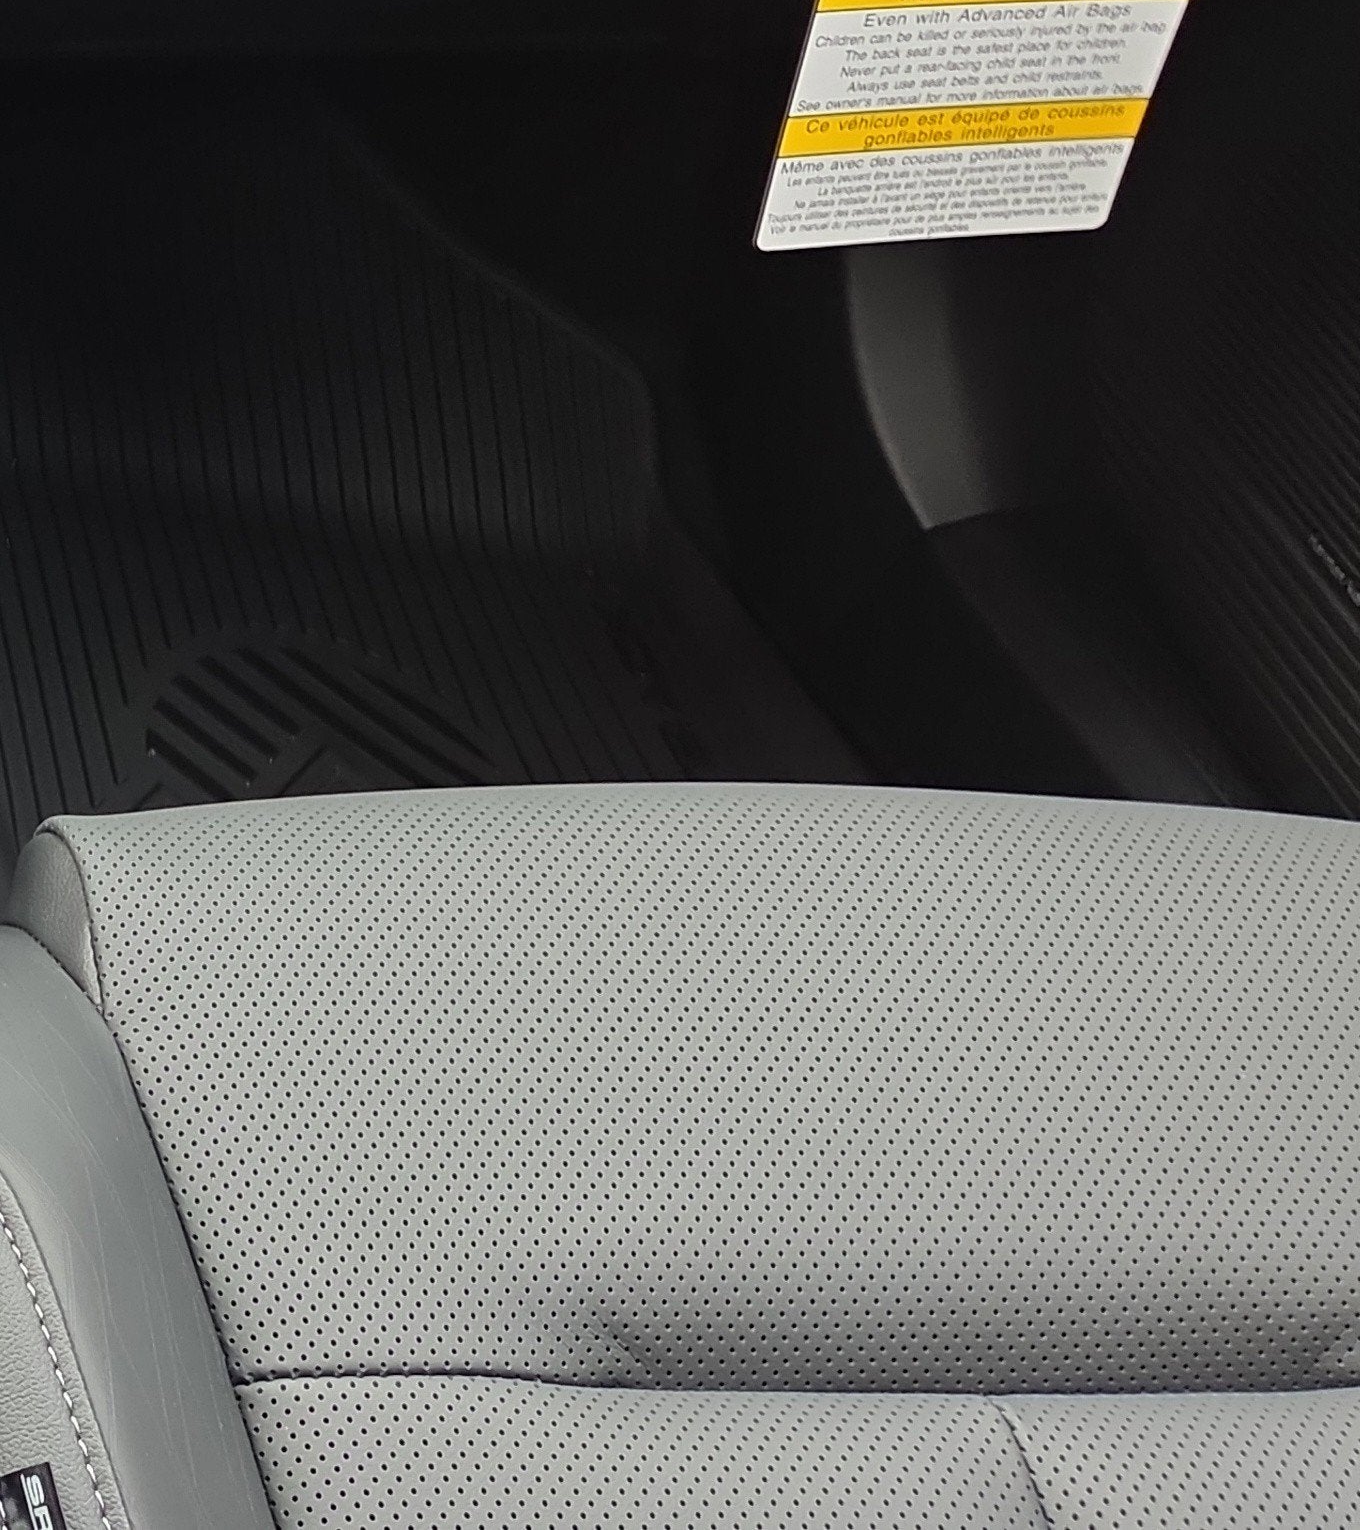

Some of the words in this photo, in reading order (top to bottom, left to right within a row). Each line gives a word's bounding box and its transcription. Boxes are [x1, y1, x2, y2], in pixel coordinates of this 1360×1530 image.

[863, 13, 908, 27] Even
[916, 10, 951, 25] with
[958, 5, 1047, 23] Advanced
[1053, 4, 1080, 19] Air
[1086, 2, 1133, 20] Bags
[815, 35, 865, 48] Children
[870, 33, 892, 45] can
[897, 31, 913, 43] be
[918, 28, 949, 41] killed
[953, 30, 967, 40] or
[1096, 22, 1117, 34] the
[845, 50, 868, 62] The
[872, 48, 900, 61] back
[906, 47, 933, 59] seat
[936, 46, 947, 56] is
[952, 44, 971, 56] the
[840, 65, 876, 78] Never
[880, 64, 901, 76] put
[1019, 56, 1047, 68] seat
[1067, 53, 1087, 66] the
[847, 80, 889, 94] Always
[893, 80, 916, 90] use
[920, 77, 948, 89] seat
[951, 74, 981, 87] belts
[984, 72, 1009, 85] and
[797, 99, 821, 113] See
[877, 93, 922, 106] manual
[925, 91, 943, 103] for
[946, 91, 978, 103] more
[806, 119, 830, 134] Ce
[838, 115, 910, 132] véhicule
[917, 112, 945, 126] est
[951, 108, 1011, 126] équipé
[1018, 107, 1040, 121] de
[1047, 104, 1126, 120] coussins
[961, 123, 1056, 140] intelligents
[830, 158, 864, 171] avec
[869, 155, 896, 168] des
[901, 151, 964, 167] coussins
